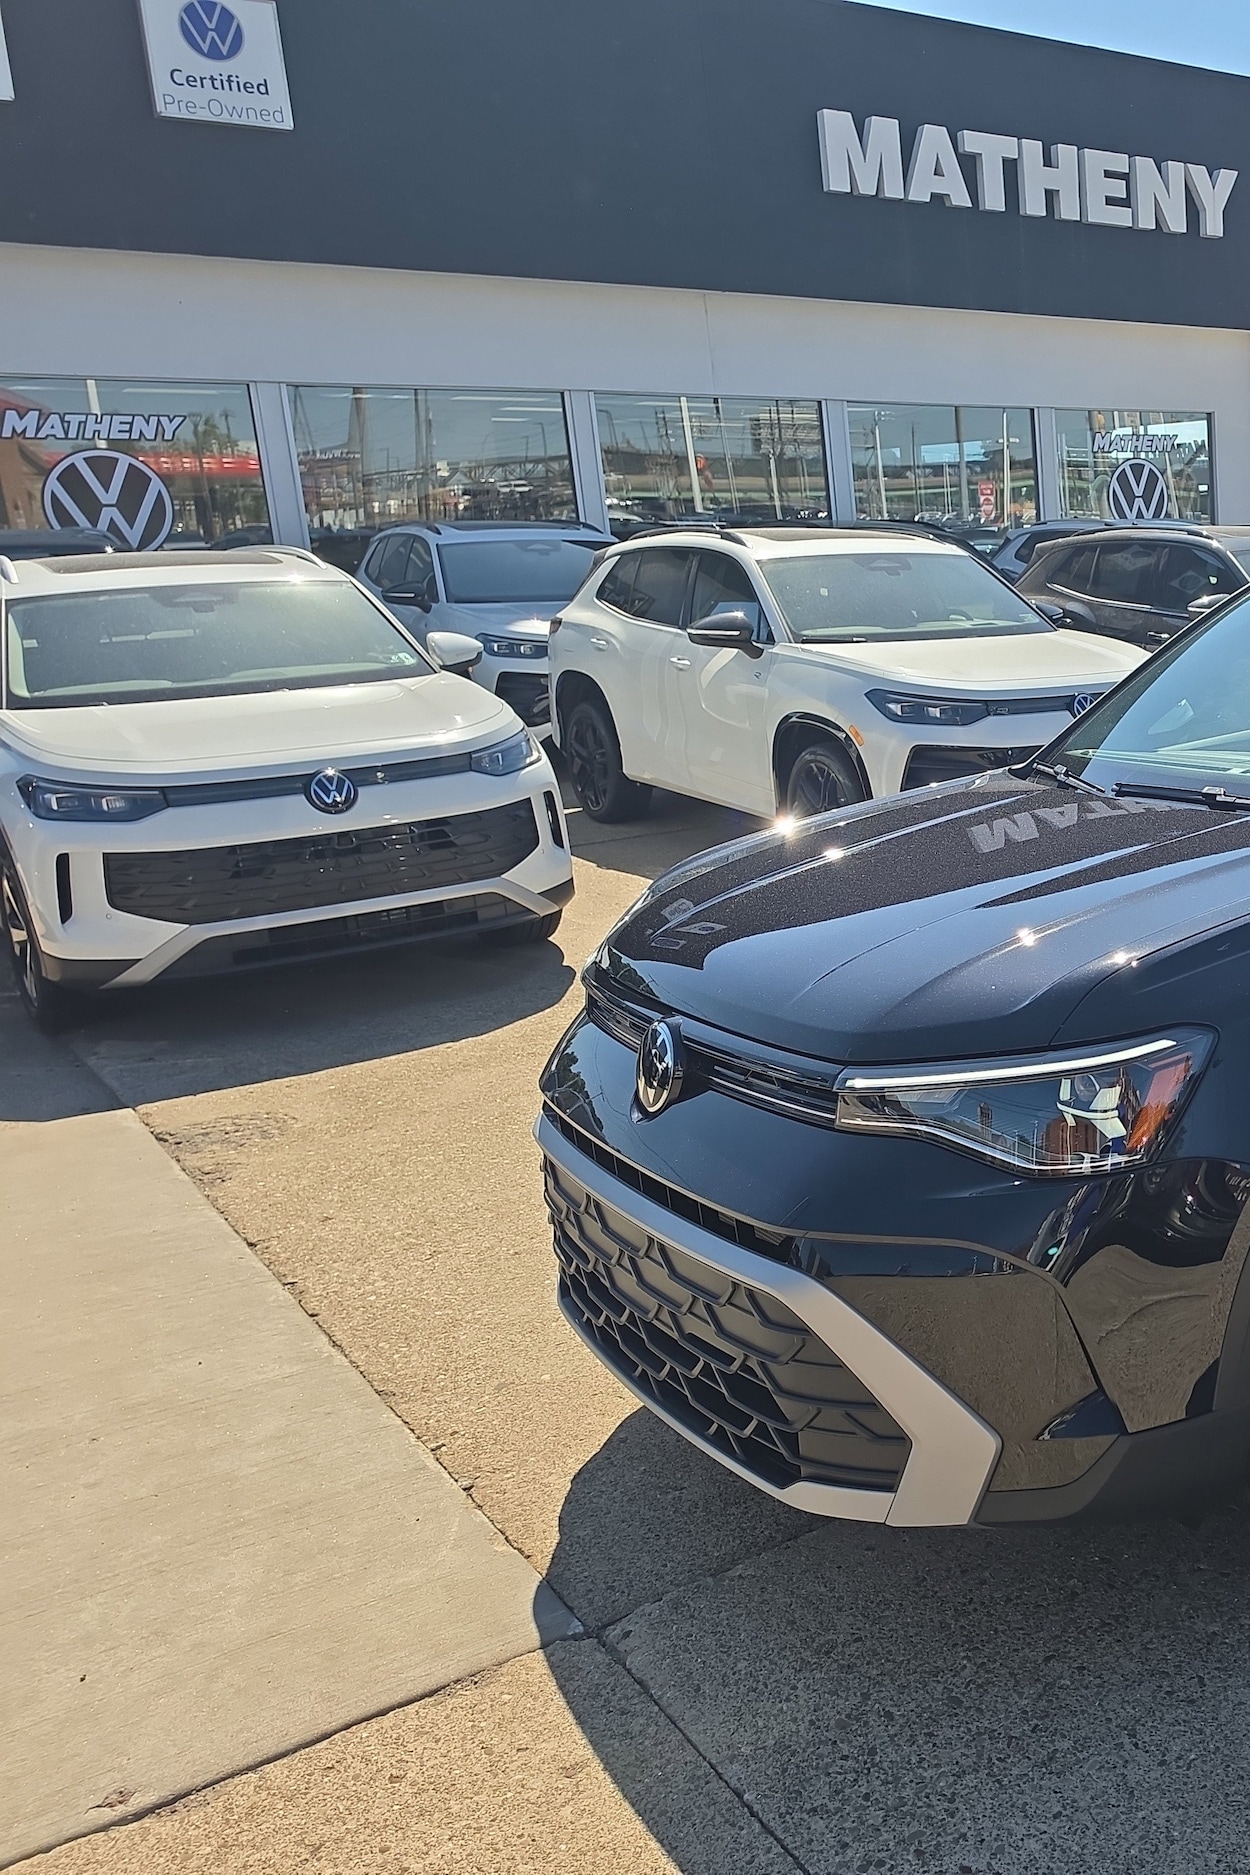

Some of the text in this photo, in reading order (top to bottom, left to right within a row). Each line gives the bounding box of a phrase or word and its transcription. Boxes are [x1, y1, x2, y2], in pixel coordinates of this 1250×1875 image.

[169, 67, 270, 97] Certified
[162, 92, 285, 124] Pre-Owned
[816, 107, 1238, 238] MATHENY
[1, 409, 187, 440] MATHENY
[1093, 431, 1178, 453] MATHENY
